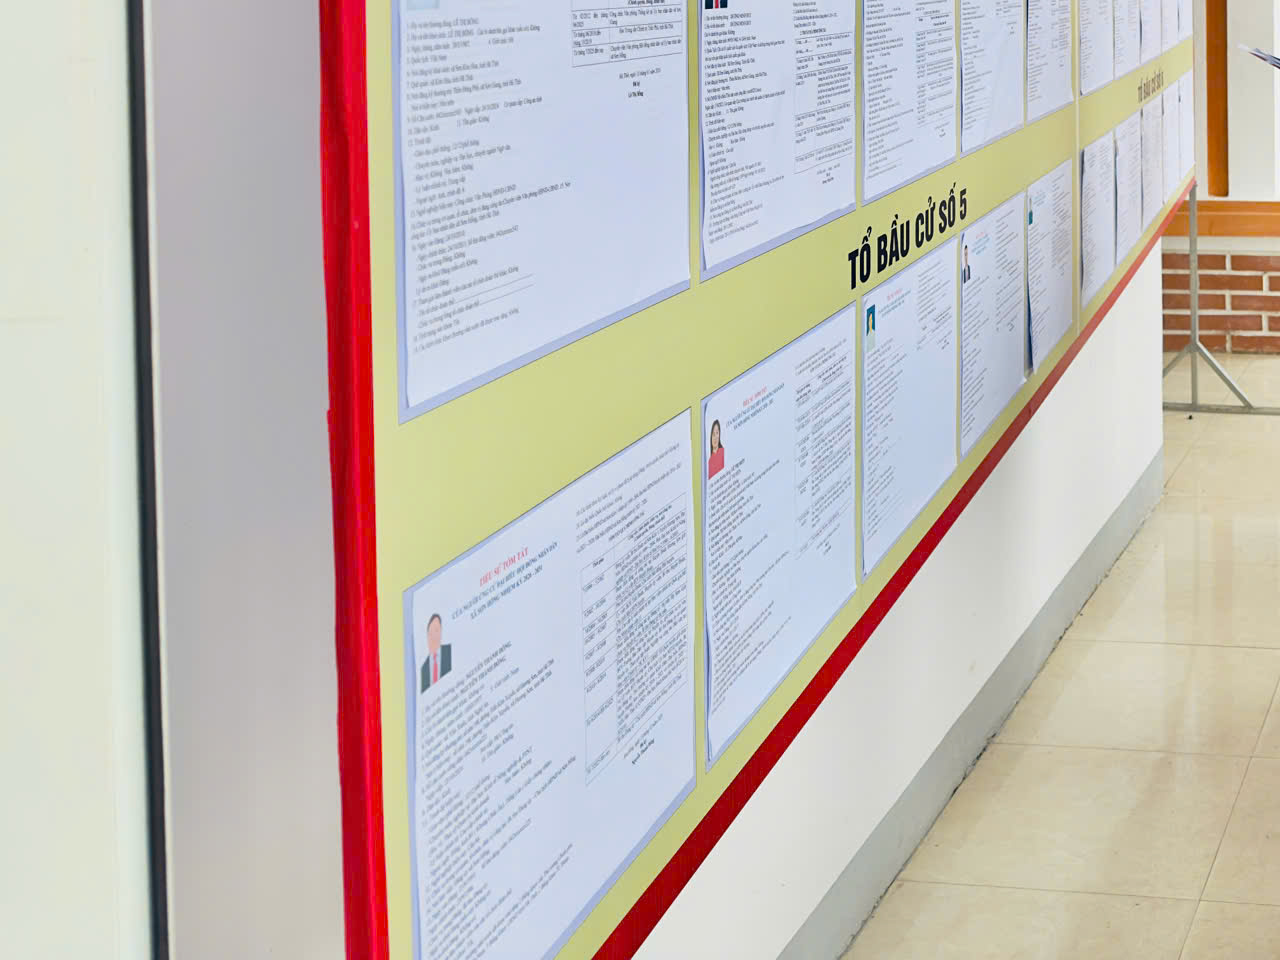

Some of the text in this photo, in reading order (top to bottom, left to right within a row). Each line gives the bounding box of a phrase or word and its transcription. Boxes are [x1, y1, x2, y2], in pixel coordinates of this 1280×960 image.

[848, 182, 967, 290] TỔ BẦU CỬ SỐ 5
